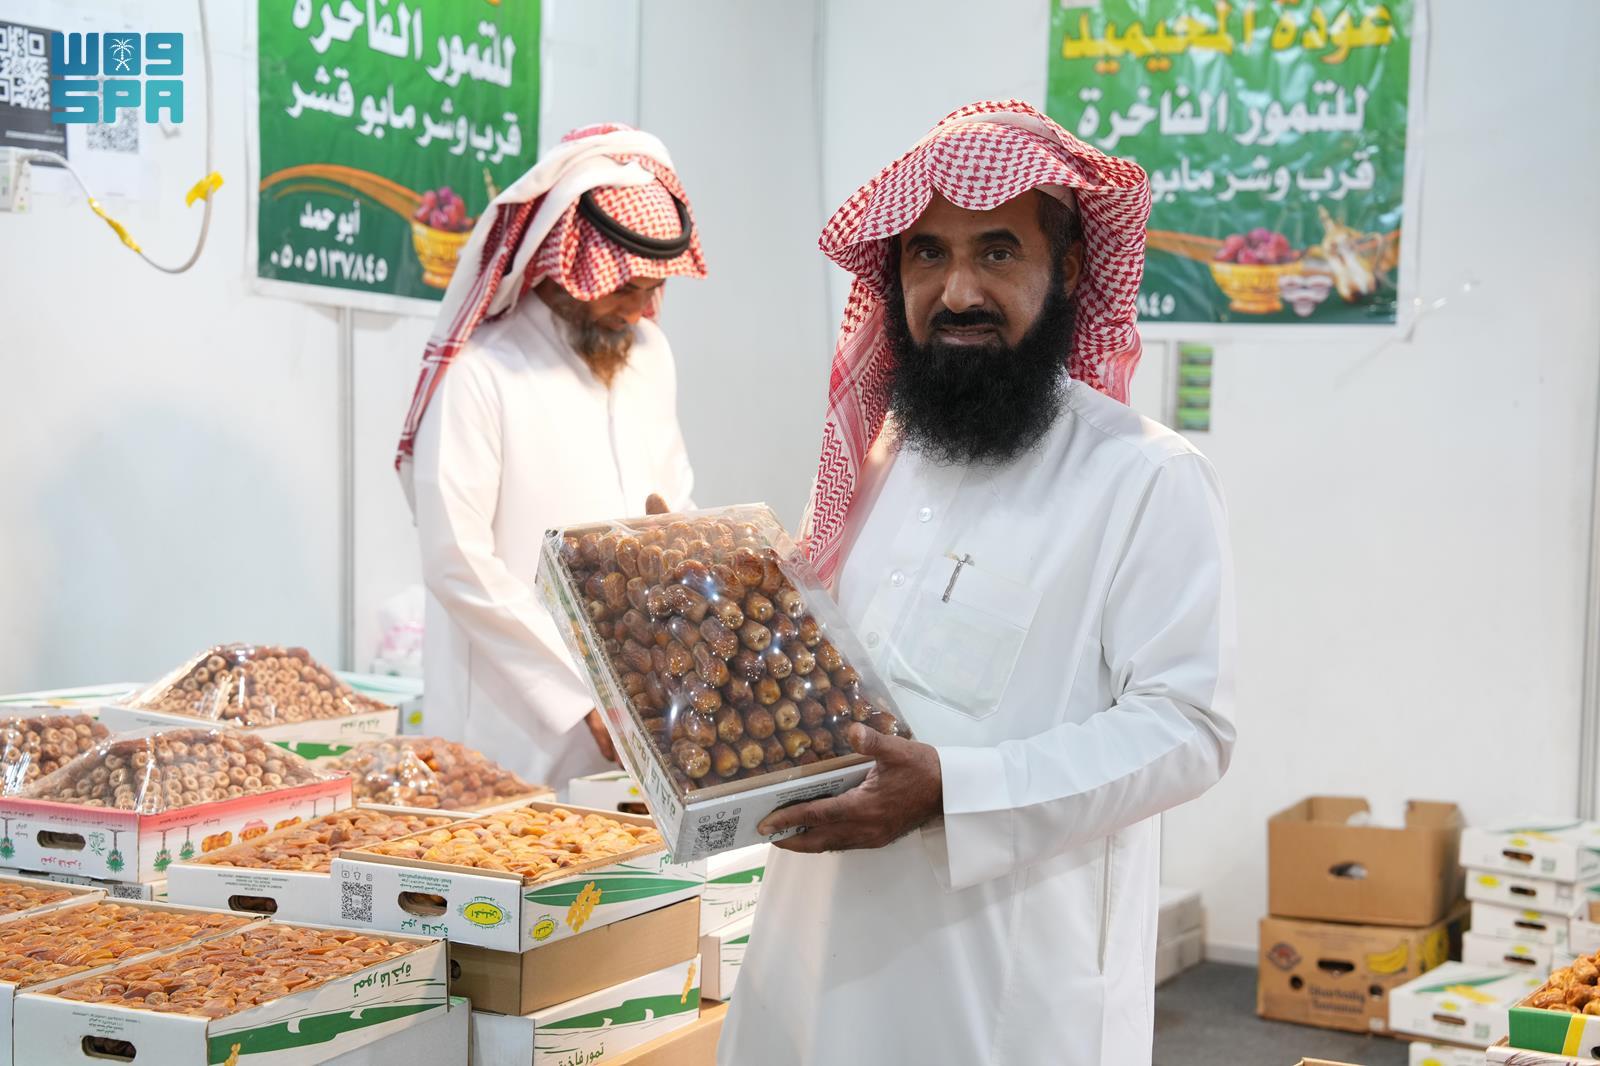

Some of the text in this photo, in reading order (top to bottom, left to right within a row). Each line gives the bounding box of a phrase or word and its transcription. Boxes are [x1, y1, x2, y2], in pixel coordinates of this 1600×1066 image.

[424, 19, 518, 88] للتمور
[285, 65, 355, 119] قشر
[1077, 80, 1369, 149] للتمور الفاخرة
[469, 111, 523, 164] قرب
[1216, 153, 1292, 202] وشر
[1295, 149, 1377, 202] قرب
[299, 200, 336, 231] حمد
[353, 961, 412, 998] تمور فاخرة
